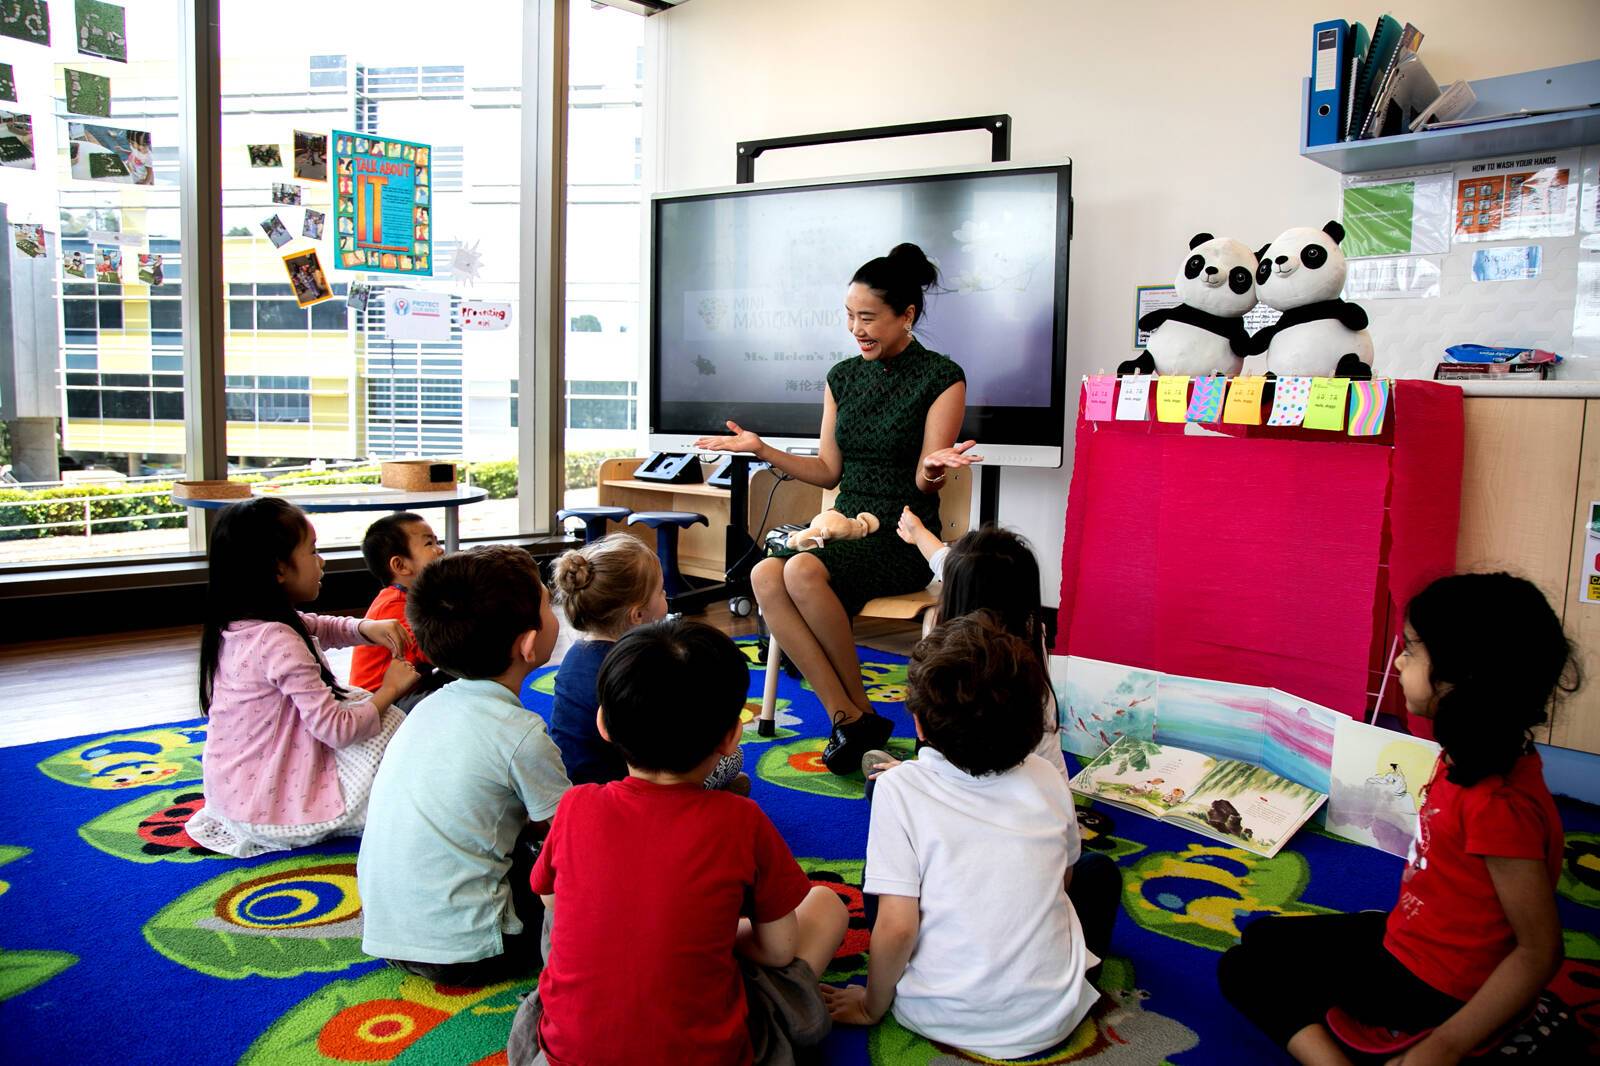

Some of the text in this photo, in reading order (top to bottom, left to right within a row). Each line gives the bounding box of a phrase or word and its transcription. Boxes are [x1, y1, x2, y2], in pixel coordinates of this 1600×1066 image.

[354, 157, 411, 177] TALK ABOUT
[1472, 156, 1557, 172] HOW TO WASH YOUR HANDS
[357, 174, 389, 243] IT
[734, 296, 764, 310] MINI
[744, 352, 768, 361] Ms.
[774, 352, 824, 361] Helen's
